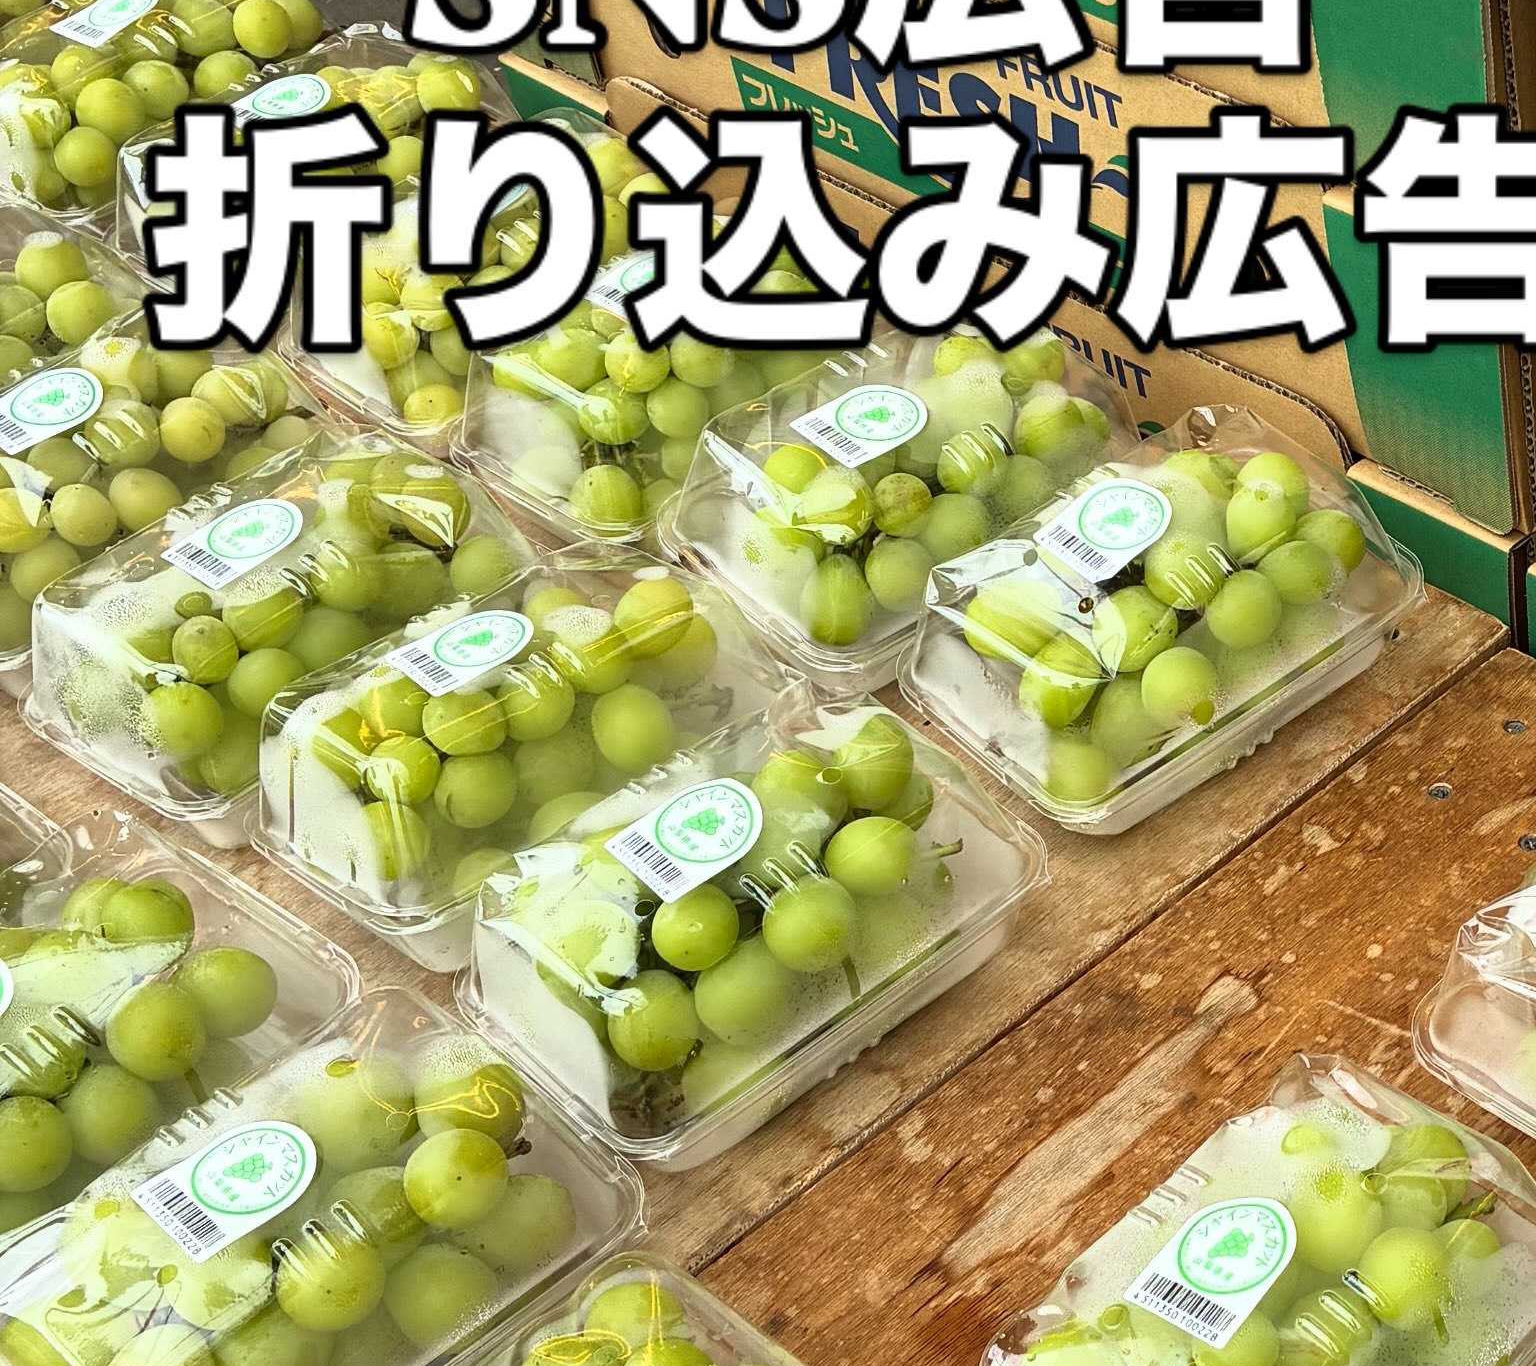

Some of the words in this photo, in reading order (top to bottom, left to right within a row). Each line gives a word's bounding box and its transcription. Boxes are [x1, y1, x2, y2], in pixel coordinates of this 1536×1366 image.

[223, 1133, 300, 1200] シャインマスカット
[1197, 1207, 1282, 1269] シャインマスカット
